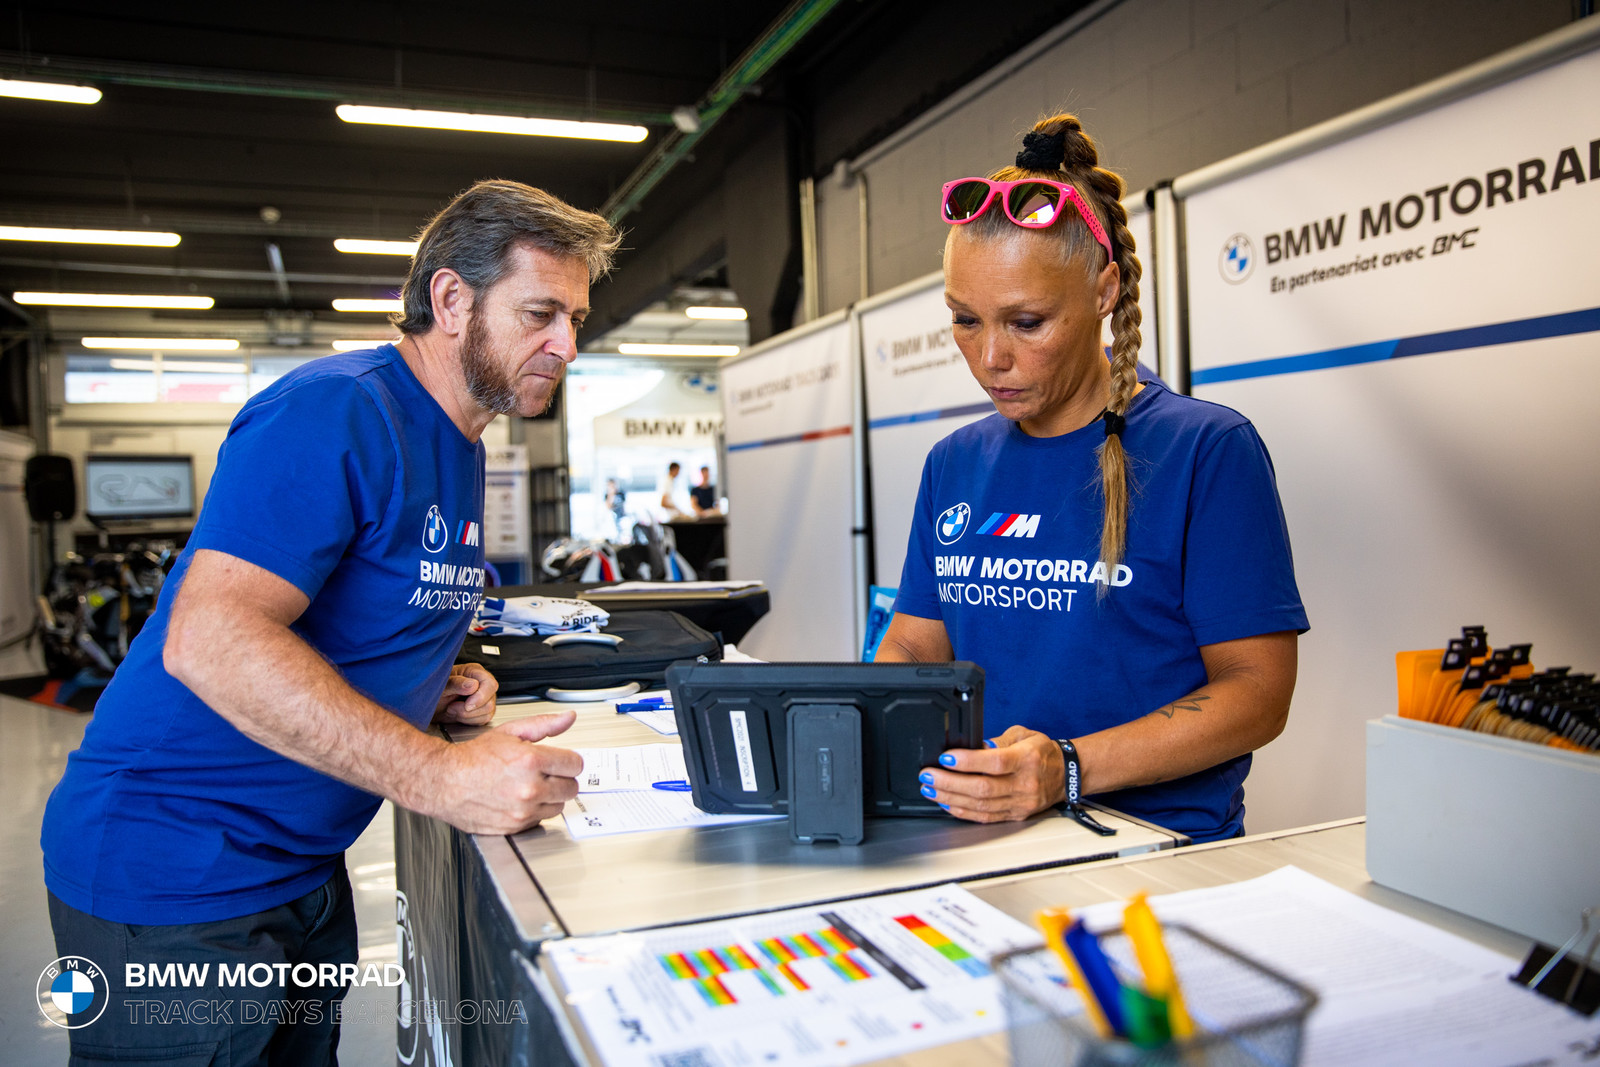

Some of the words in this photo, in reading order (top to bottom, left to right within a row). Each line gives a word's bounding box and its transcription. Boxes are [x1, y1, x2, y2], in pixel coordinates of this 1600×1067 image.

[1264, 213, 1347, 265] BMW
[1270, 275, 1287, 294] En
[1289, 255, 1378, 294] partenariat
[1382, 245, 1425, 267] avec
[1431, 227, 1480, 256] BMC
[624, 418, 685, 437] BMW
[420, 560, 457, 585] BMW
[935, 555, 976, 577] BMW
[980, 556, 1134, 587] MOTORRAD
[938, 583, 1078, 612] MOTORSPORT
